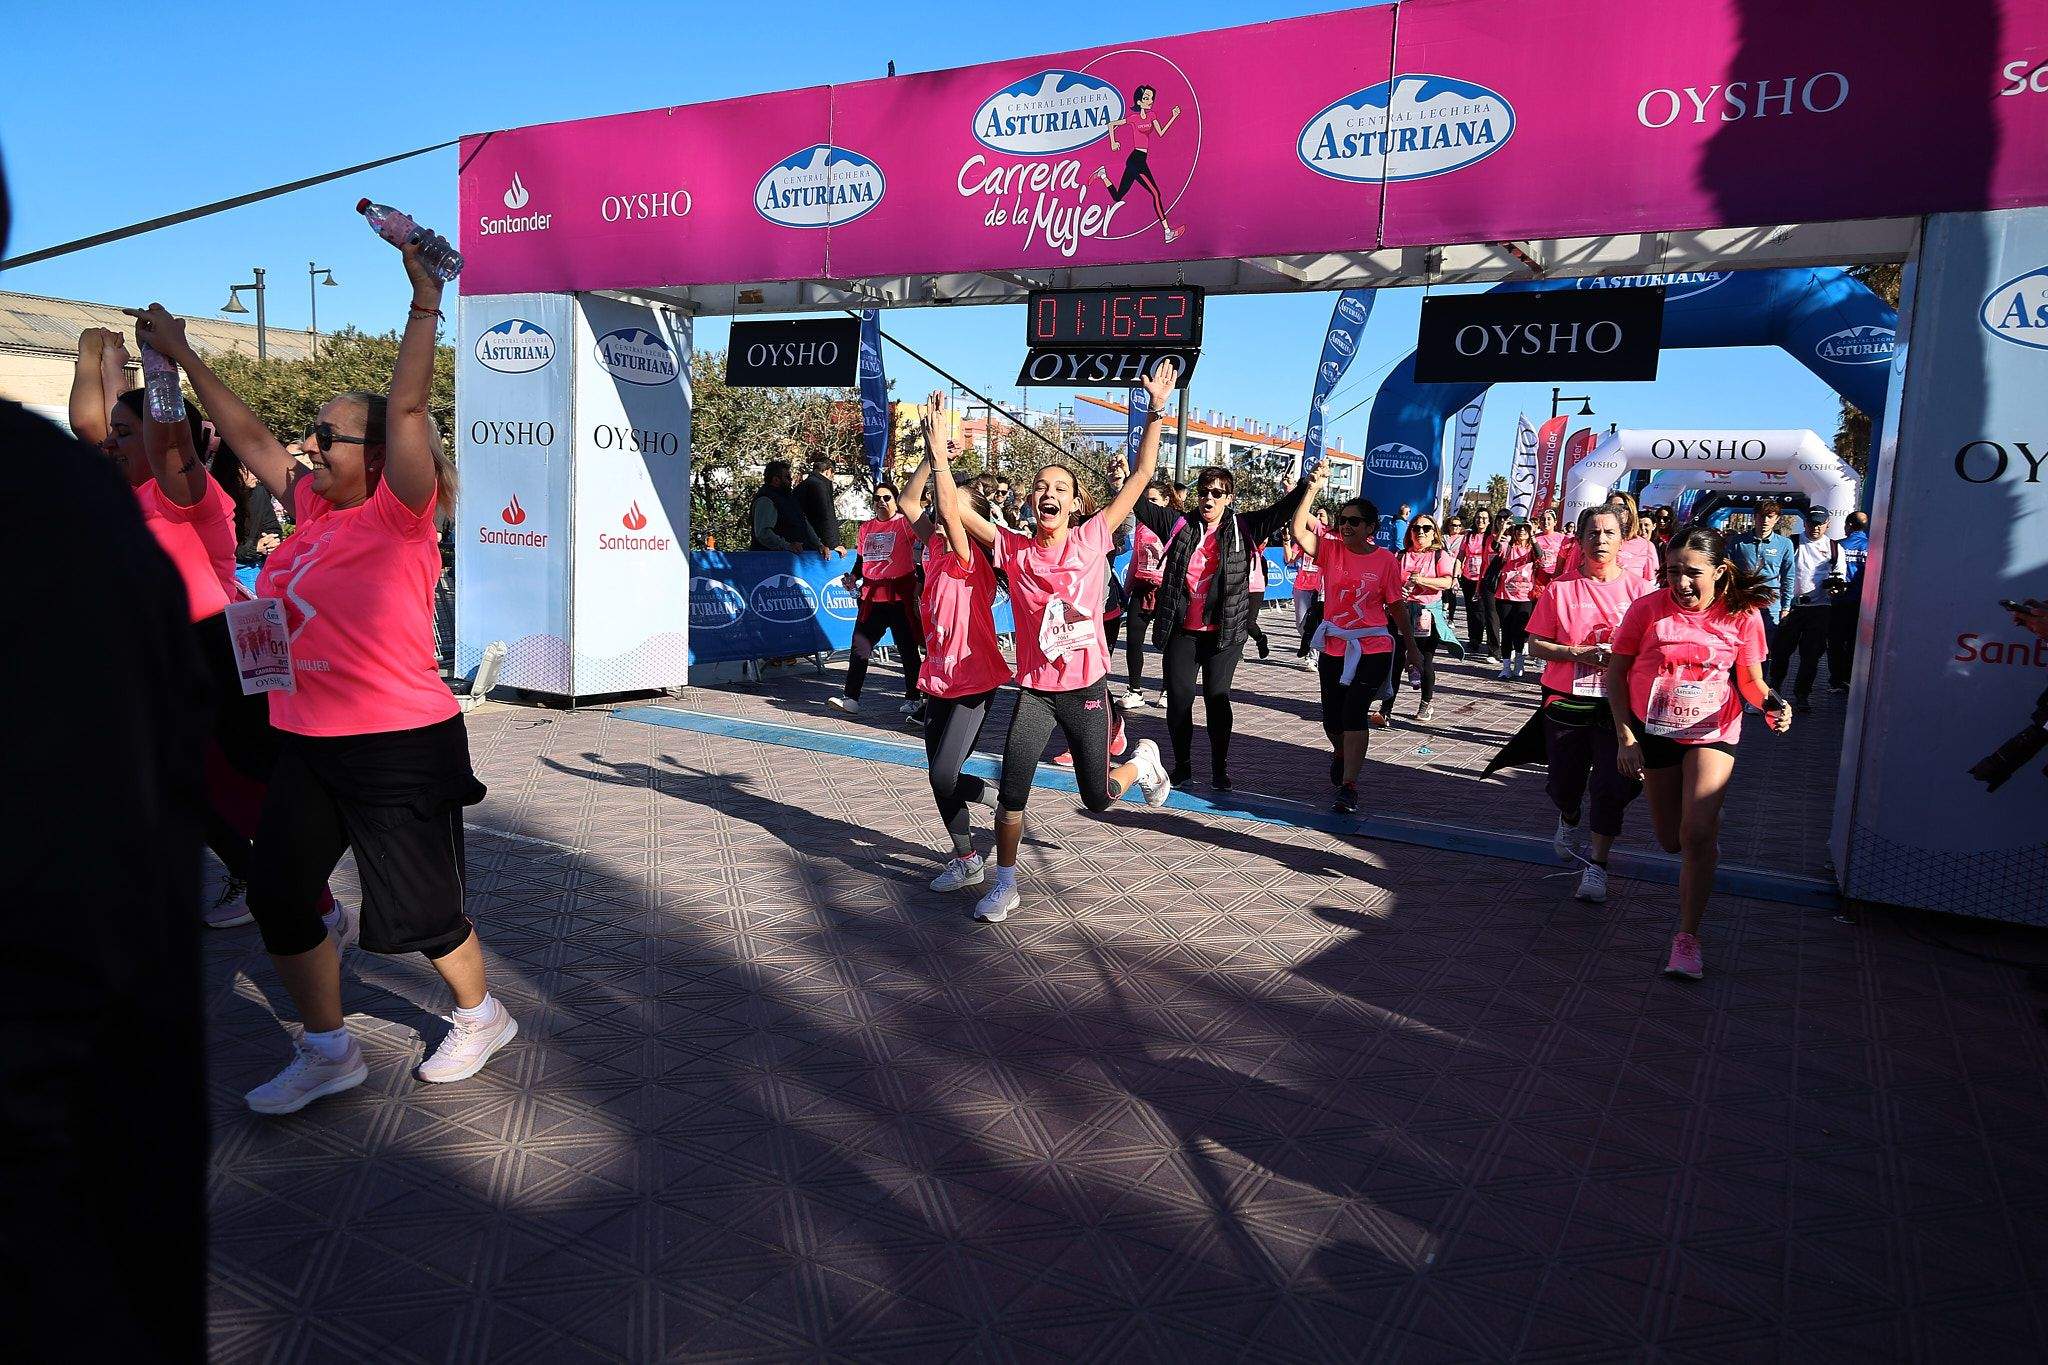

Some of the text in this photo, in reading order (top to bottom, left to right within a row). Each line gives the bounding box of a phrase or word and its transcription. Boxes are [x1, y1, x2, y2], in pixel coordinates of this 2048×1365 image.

[1007, 92, 1109, 112] CENTRAL LECHERA
[1636, 71, 1850, 128] OYSHO
[983, 104, 1112, 138] ASTURIANA
[1345, 103, 1492, 129] CENTRAL LECHERA
[1311, 118, 1496, 161] ASTURIANA
[783, 170, 871, 185] CENTRAL ECHERA
[956, 153, 1081, 197] Carrera
[601, 190, 692, 222] OYSHO
[763, 180, 875, 209] ASTURIANA
[480, 211, 552, 236] Santander
[984, 185, 1126, 258] de la Mujer
[481, 340, 550, 360] ASTURIANA
[1454, 320, 1623, 356] OYSHO
[602, 342, 675, 376] ASTURIANA
[747, 341, 838, 367] OYSHO
[1029, 353, 1187, 382] OYSHO
[471, 420, 555, 446] OYSHO
[594, 424, 679, 456] OYSHO
[1540, 431, 1558, 486] Santander
[1650, 438, 1767, 461] OYSHO
[1368, 455, 1424, 471] ASTURIANA
[1585, 461, 1618, 469] OYSHO
[1799, 463, 1837, 471] OYSHO
[1727, 494, 1793, 503] VOLVO
[479, 526, 548, 548] Santander
[599, 533, 671, 551] Santander
[757, 592, 816, 612] ASTURIANA
[296, 659, 331, 672] MUJER
[1673, 706, 1701, 717] 016
